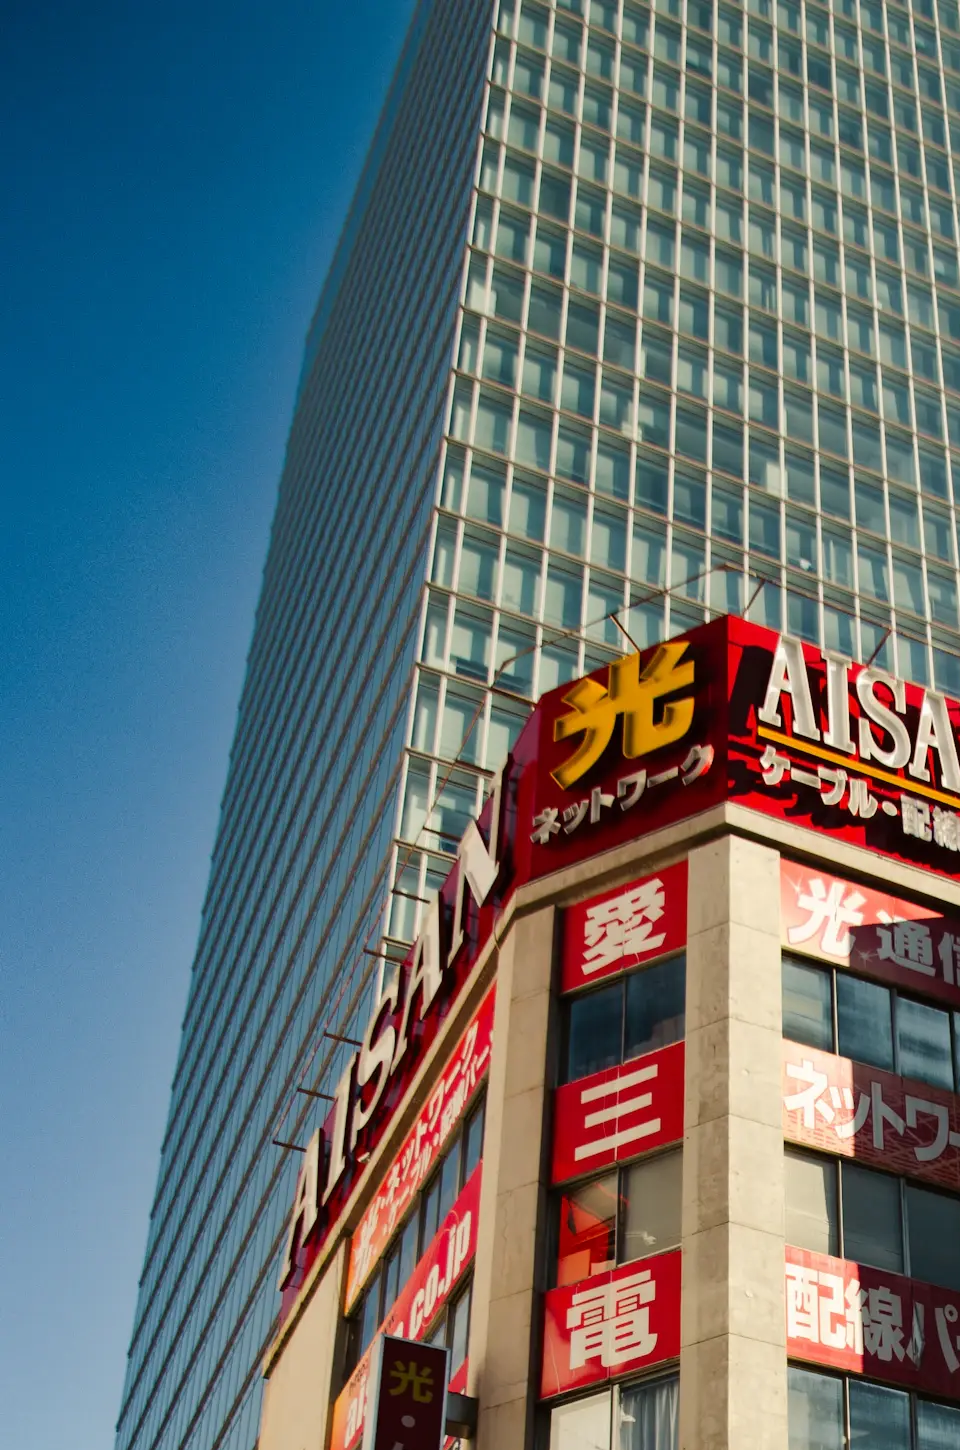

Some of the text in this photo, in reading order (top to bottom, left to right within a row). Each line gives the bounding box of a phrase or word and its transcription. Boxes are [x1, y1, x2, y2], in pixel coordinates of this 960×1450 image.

[549, 641, 695, 790] 光
[530, 745, 714, 844] ネットワーク
[280, 781, 499, 1293] AISAN
